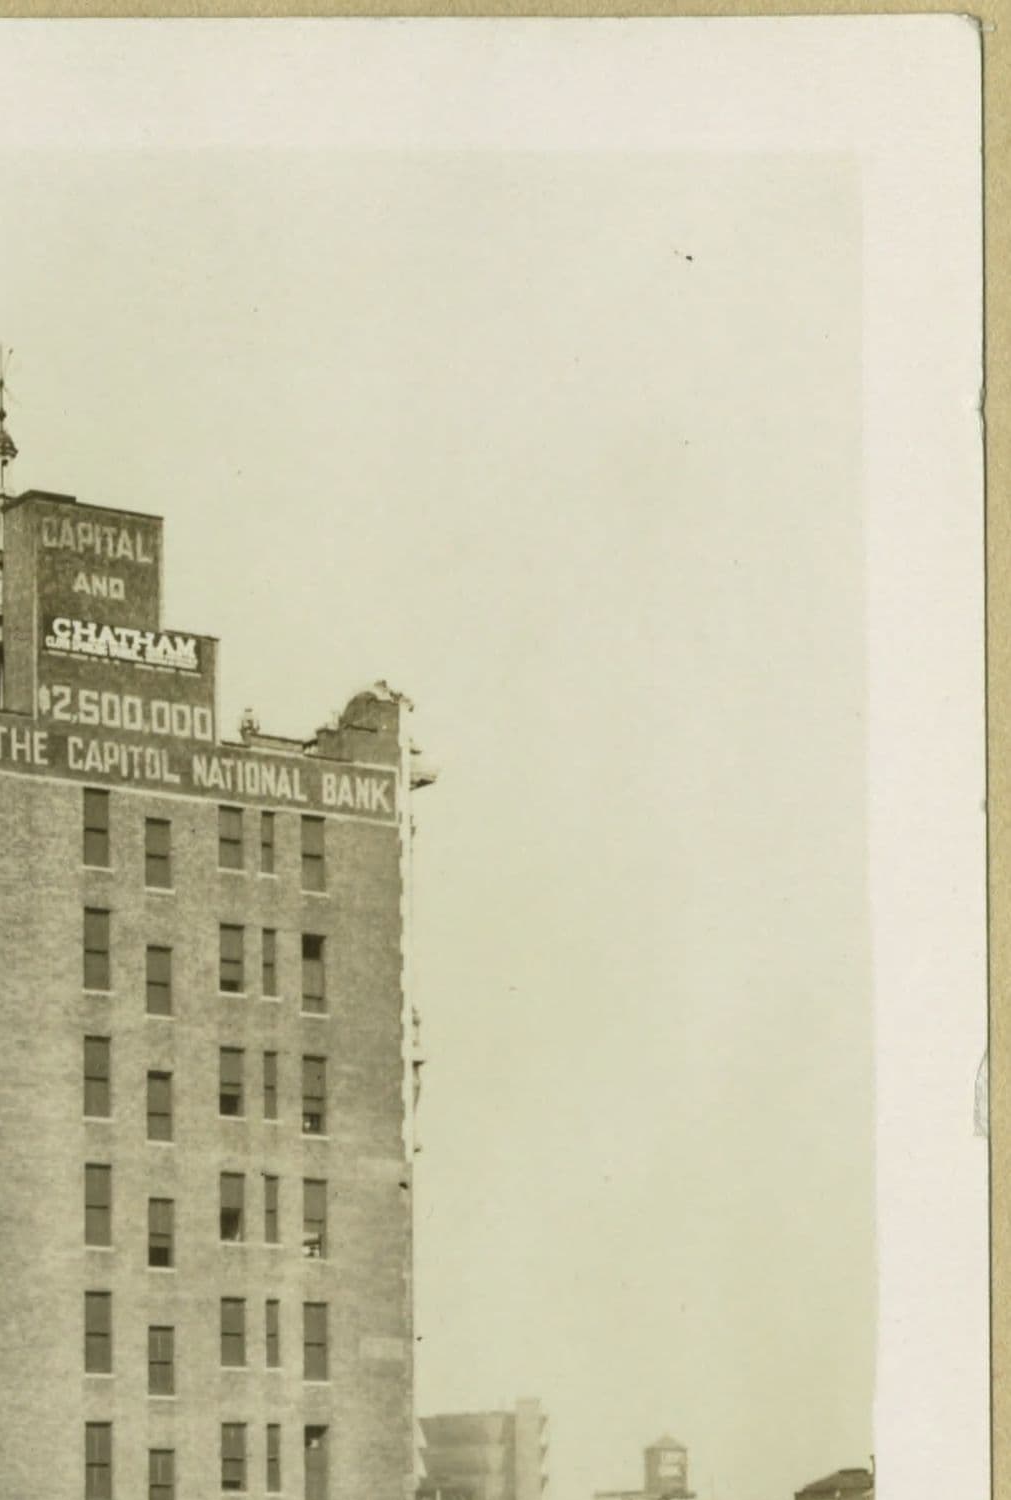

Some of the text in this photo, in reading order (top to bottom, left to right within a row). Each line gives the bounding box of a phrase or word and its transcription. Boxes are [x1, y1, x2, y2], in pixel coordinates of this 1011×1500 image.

[43, 518, 153, 563] CAPITAL
[73, 572, 124, 600] AND
[52, 617, 196, 658] CHATHAM
[67, 736, 180, 782] CAPITOL
[193, 755, 307, 801] NATIONAL
[322, 774, 390, 811] BANK
